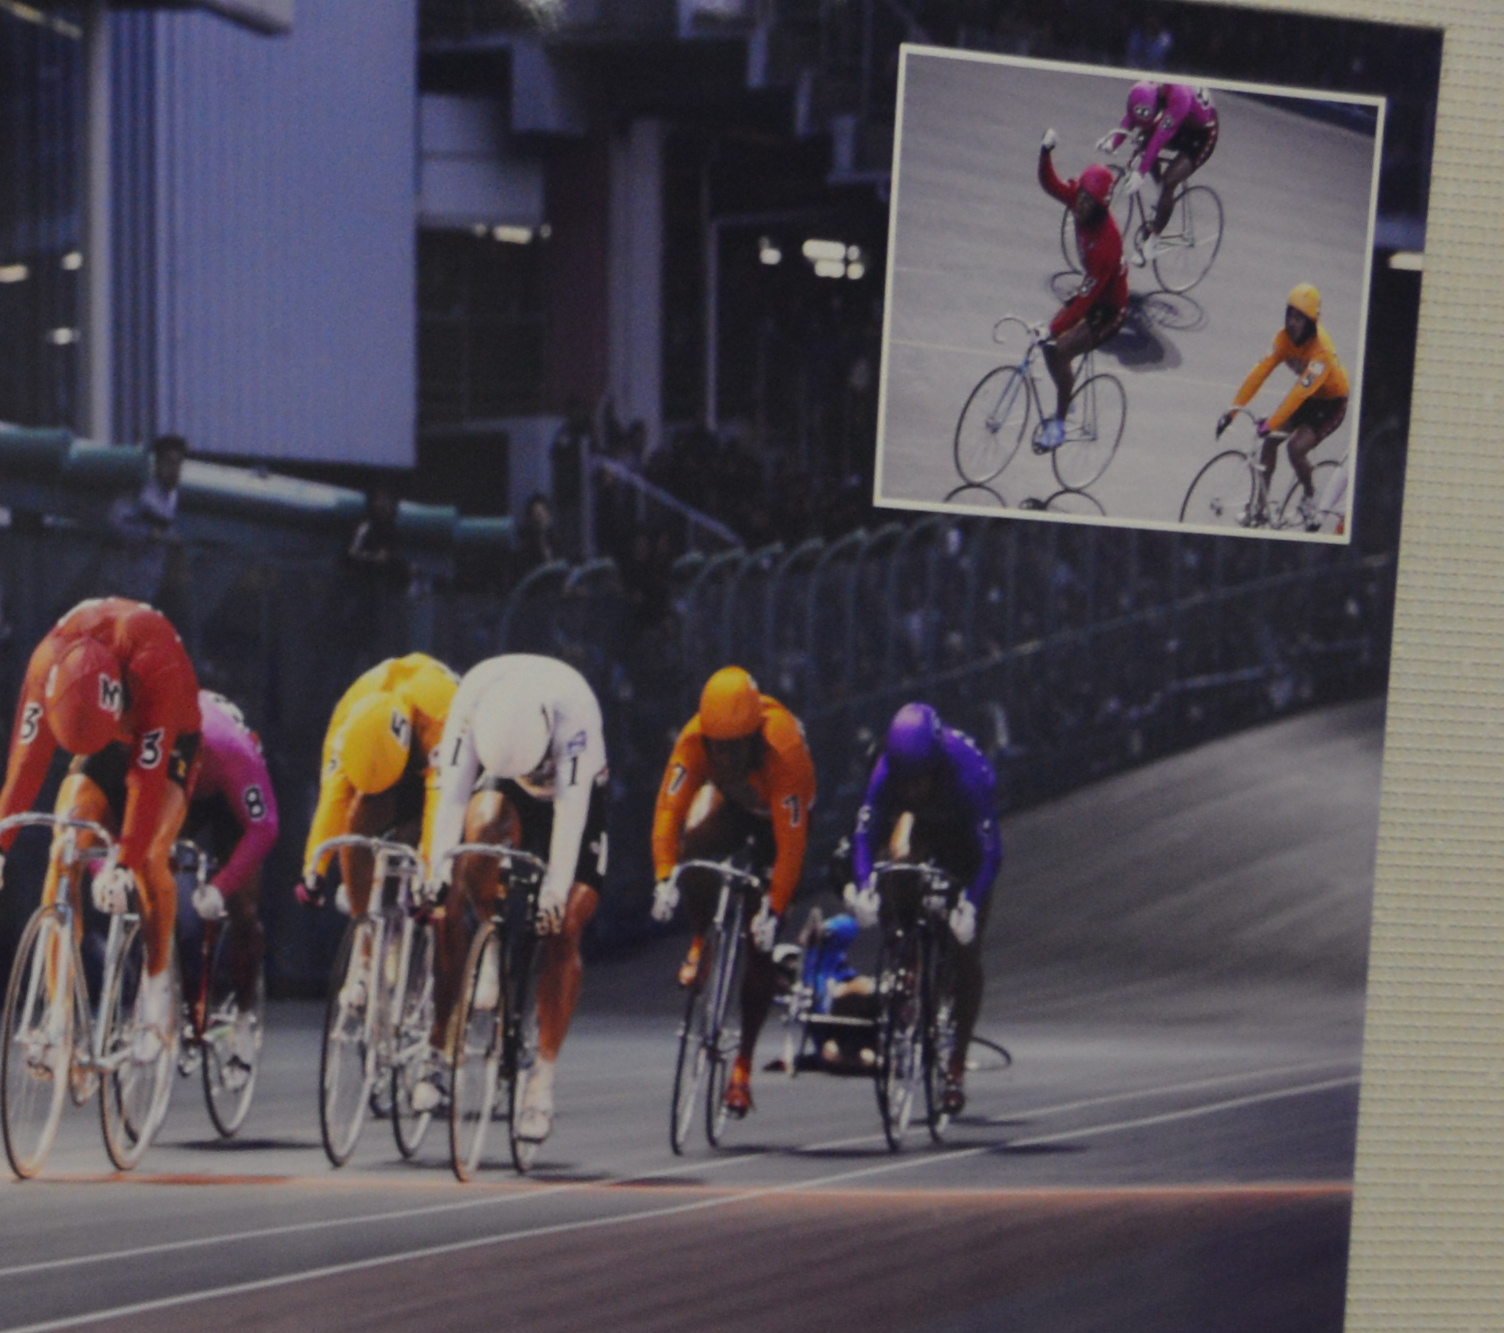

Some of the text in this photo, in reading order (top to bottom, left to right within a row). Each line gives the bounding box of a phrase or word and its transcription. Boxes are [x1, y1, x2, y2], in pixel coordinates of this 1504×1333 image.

[20, 702, 43, 745] 3
[139, 728, 165, 770] 3
[451, 736, 463, 768] 1
[568, 753, 580, 787] 1
[665, 762, 688, 798] 7
[243, 786, 266, 822] 8
